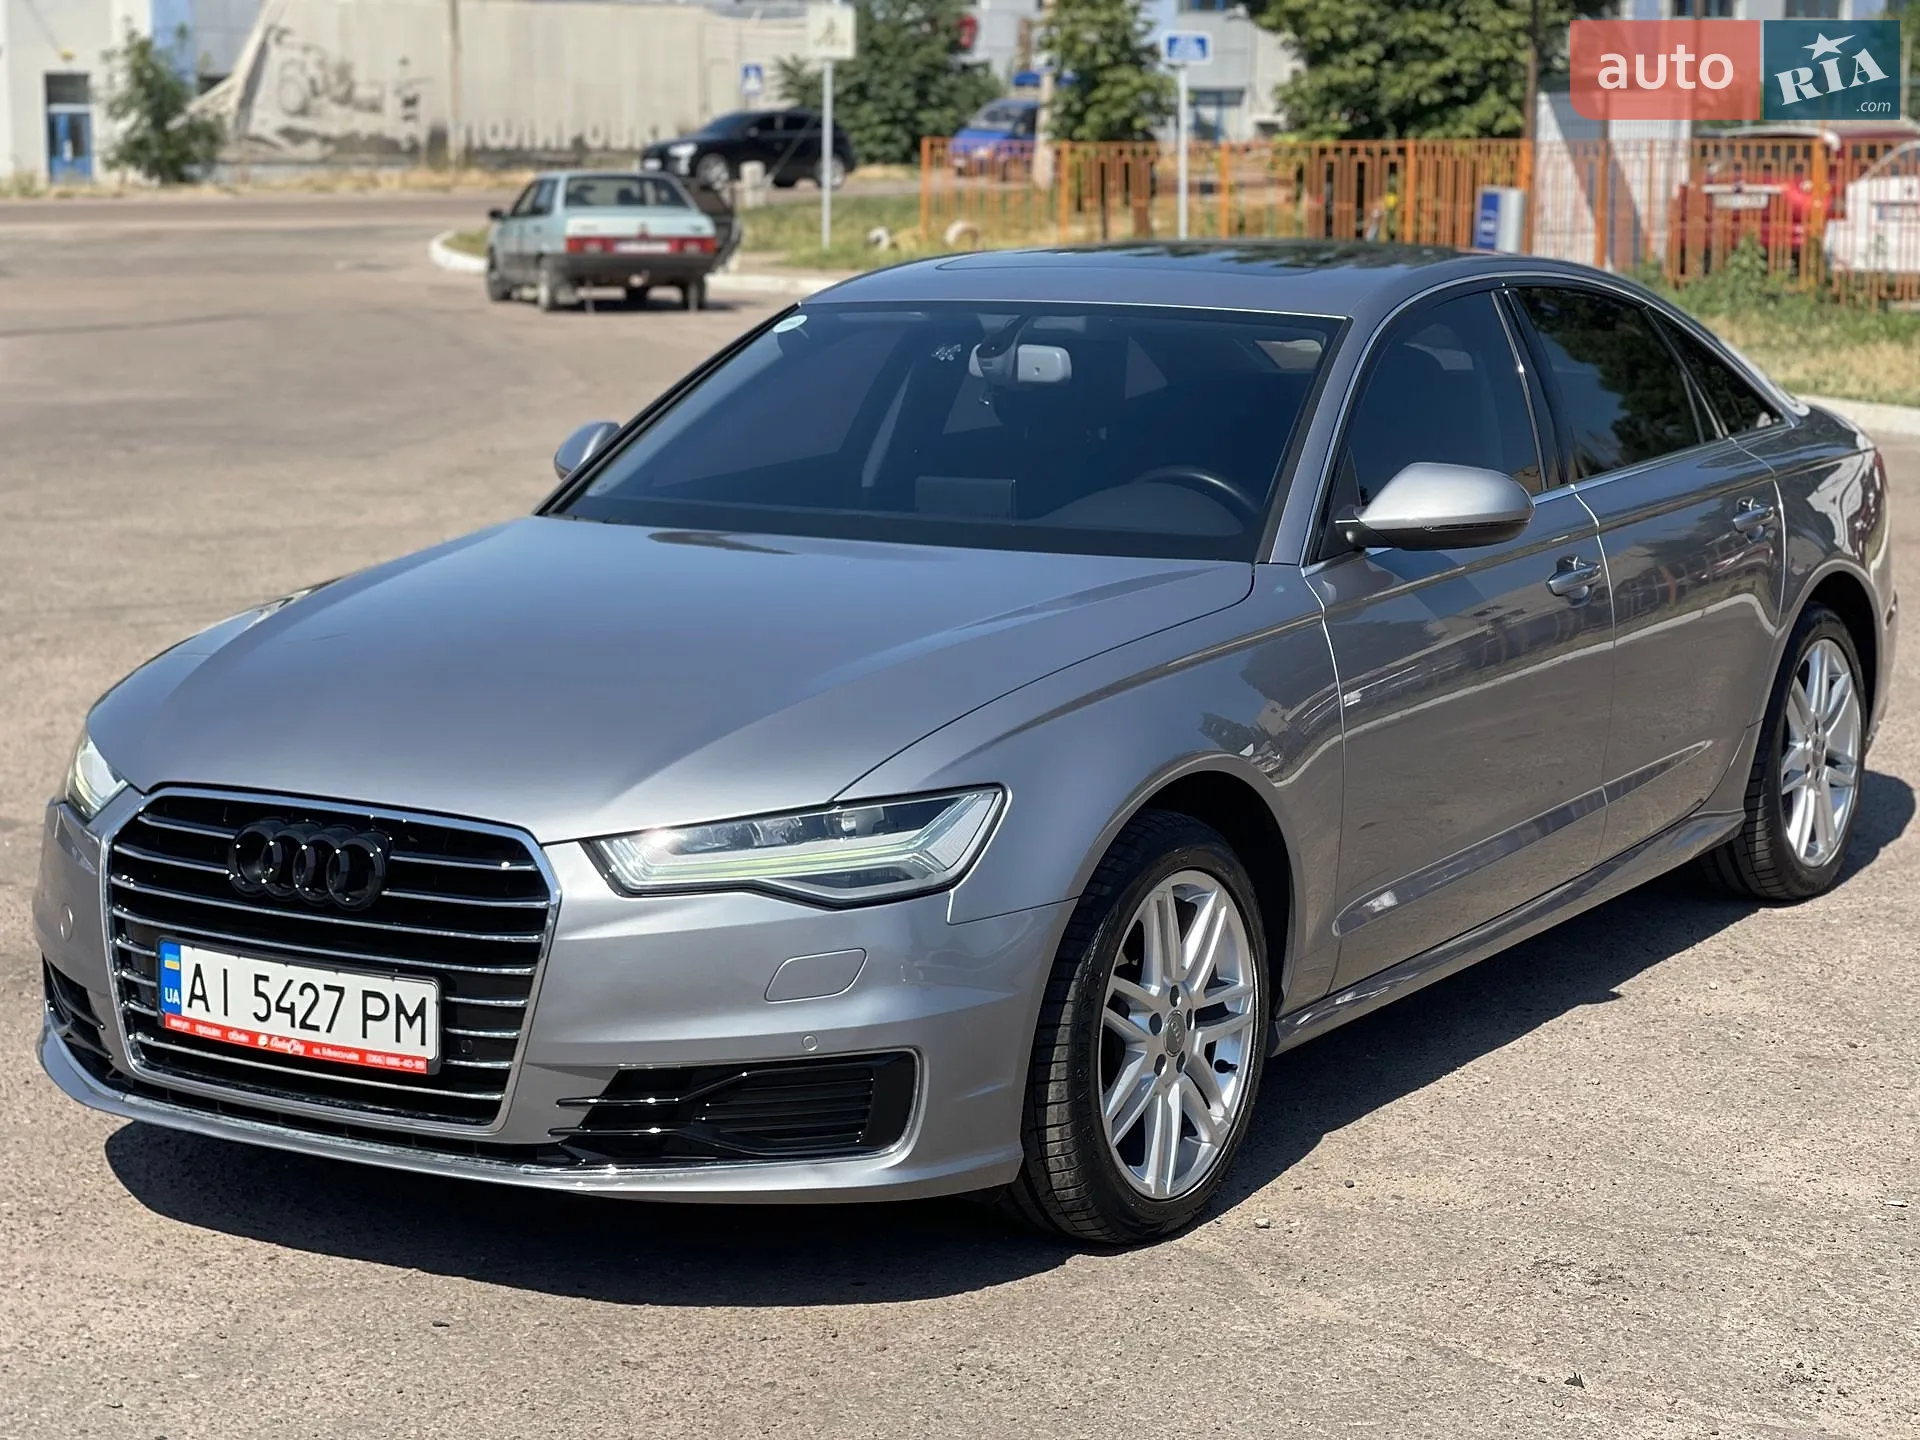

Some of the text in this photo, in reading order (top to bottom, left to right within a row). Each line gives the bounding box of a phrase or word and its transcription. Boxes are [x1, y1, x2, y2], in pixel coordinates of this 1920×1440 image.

[164, 986, 181, 1005] UA
[187, 963, 427, 1046] AI 5427 PM
